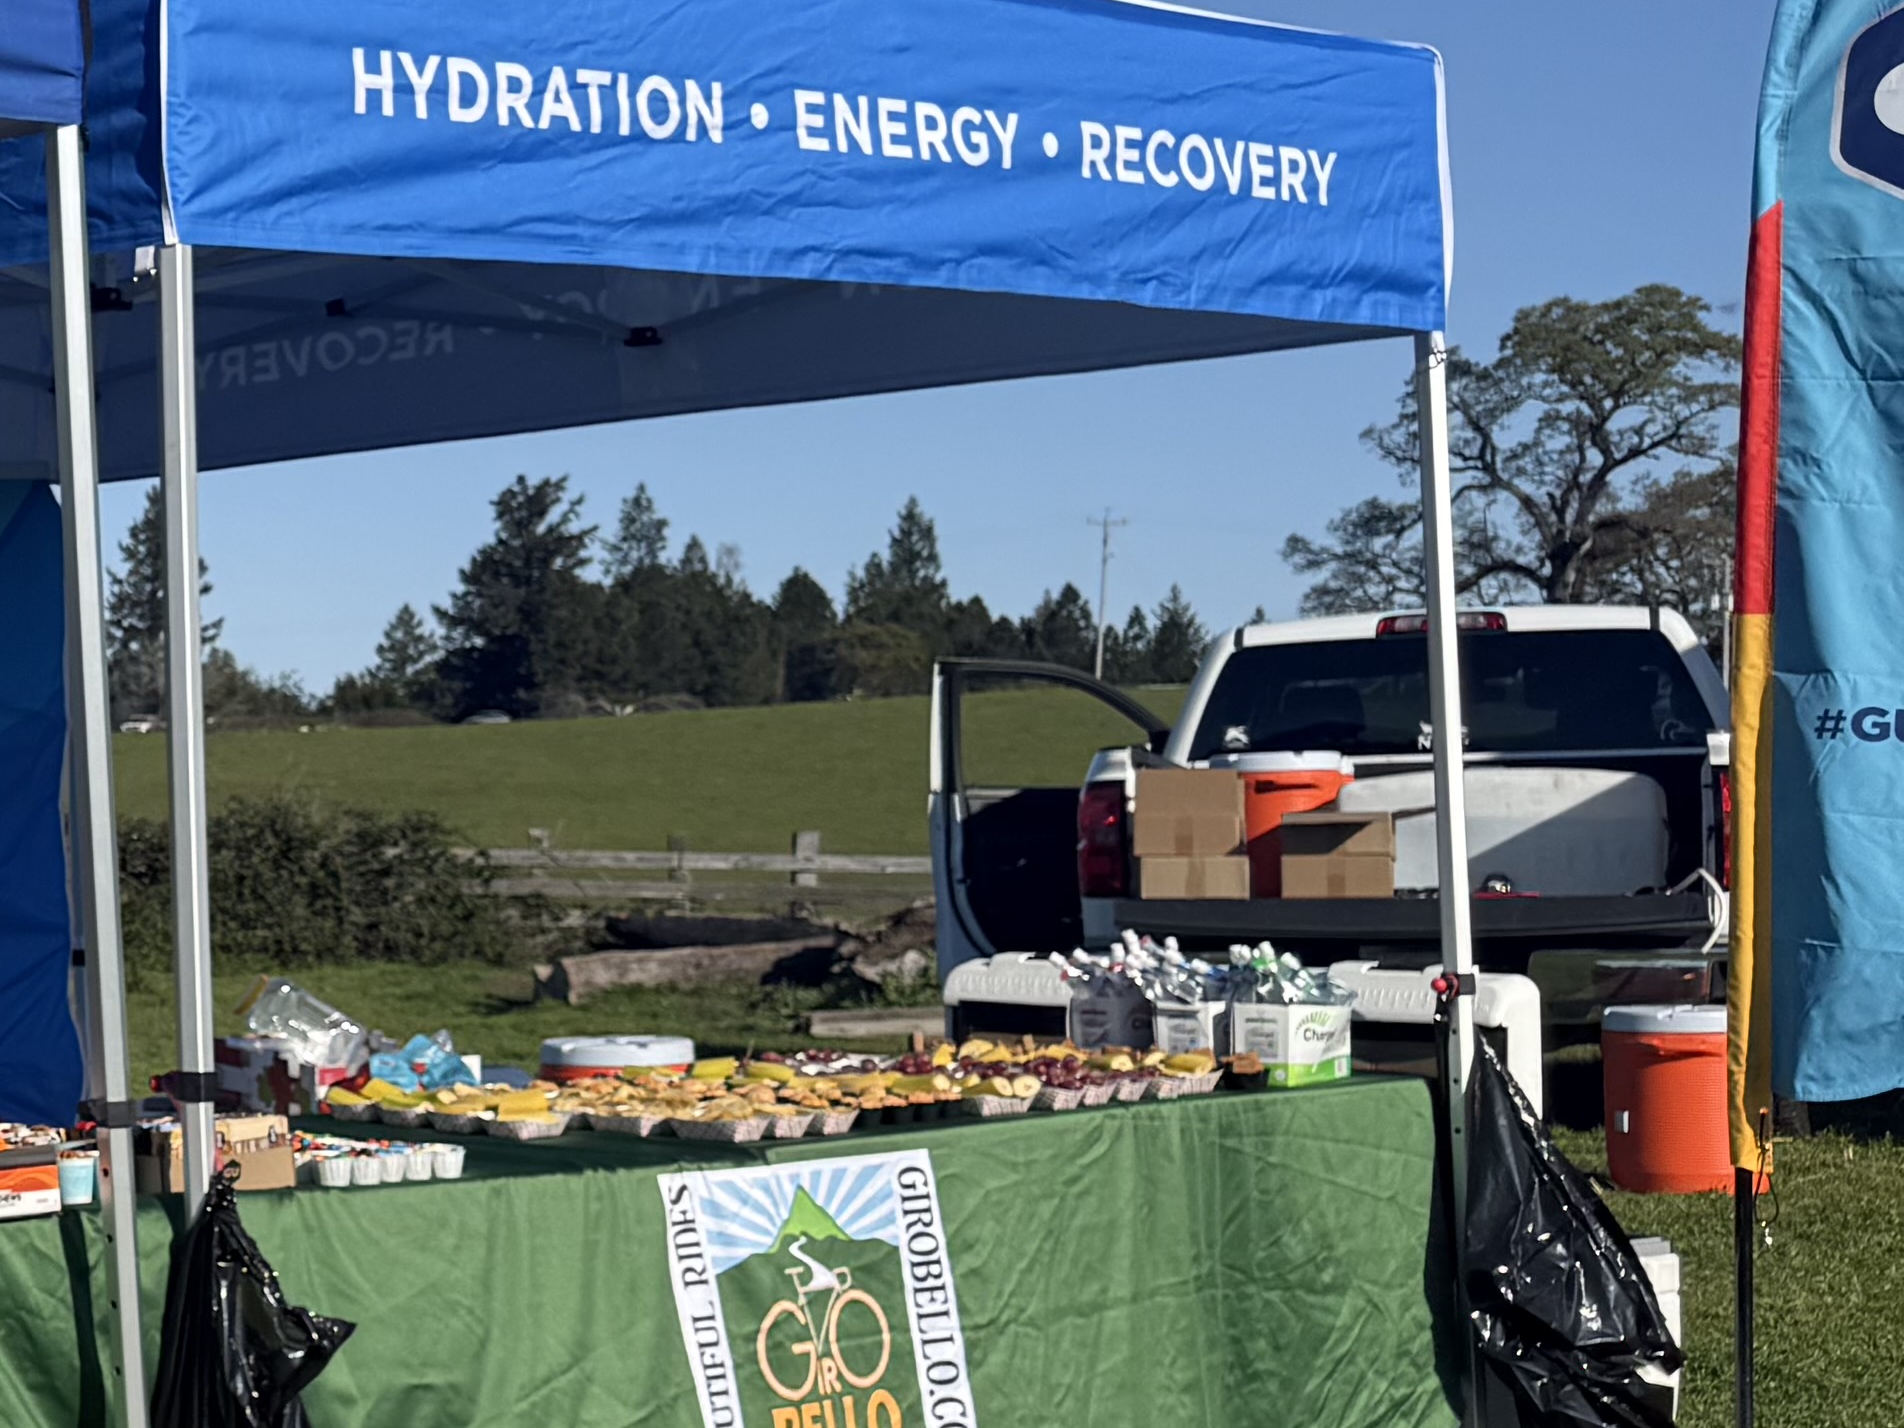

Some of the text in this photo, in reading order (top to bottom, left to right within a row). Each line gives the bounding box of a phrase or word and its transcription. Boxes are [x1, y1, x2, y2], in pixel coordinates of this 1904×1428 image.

[351, 47, 1340, 208] HYDRATION ENERGY RECOVERY
[1814, 706, 1904, 743] #G
[668, 1182, 709, 1290] RIDES
